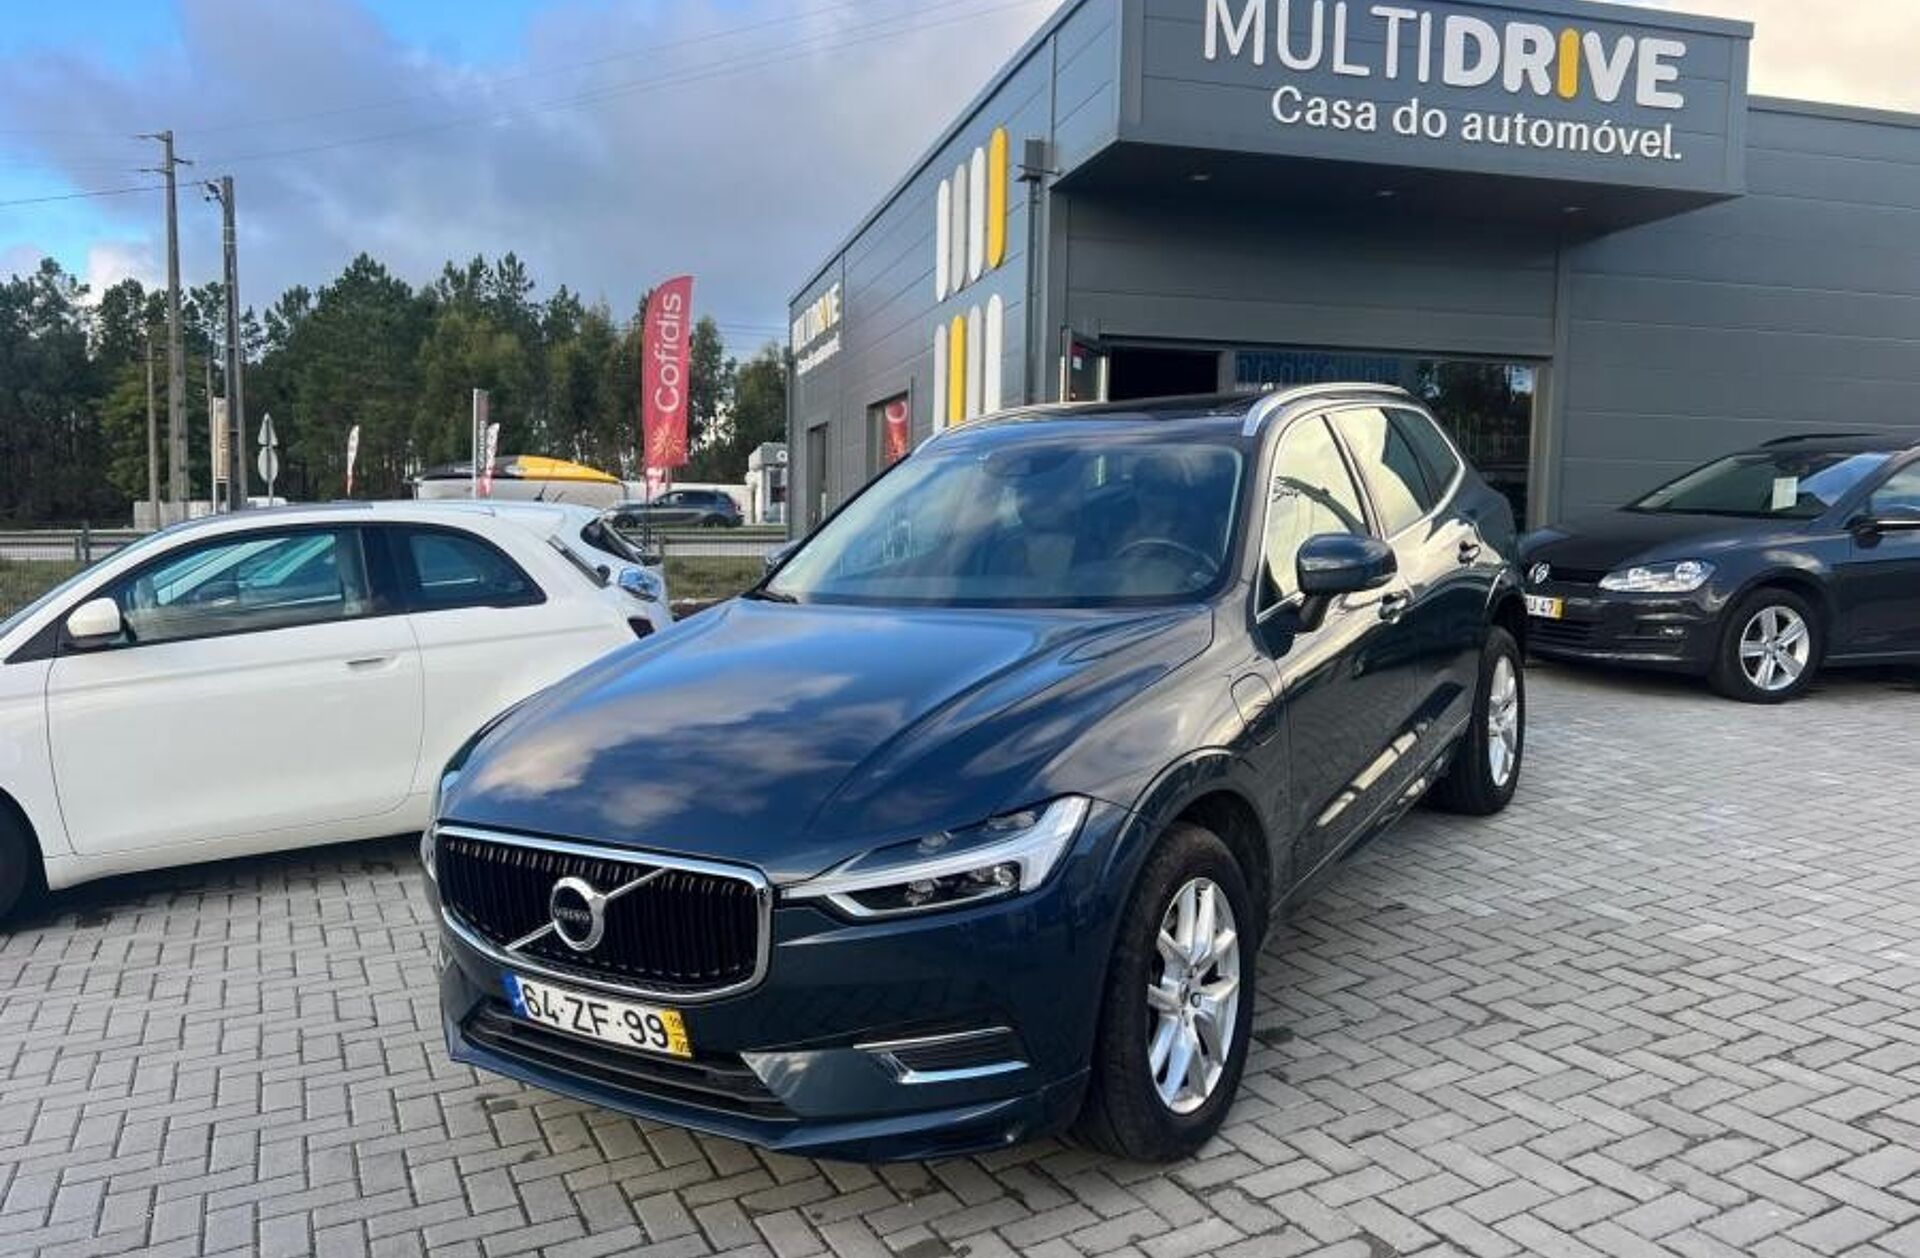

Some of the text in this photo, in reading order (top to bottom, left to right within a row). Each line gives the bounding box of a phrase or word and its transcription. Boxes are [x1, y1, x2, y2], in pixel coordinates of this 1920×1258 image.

[1203, 0, 1687, 109] MULTIDRIVE
[1271, 85, 1683, 161] Casa do automóvel.
[654, 293, 682, 413] Cofidis
